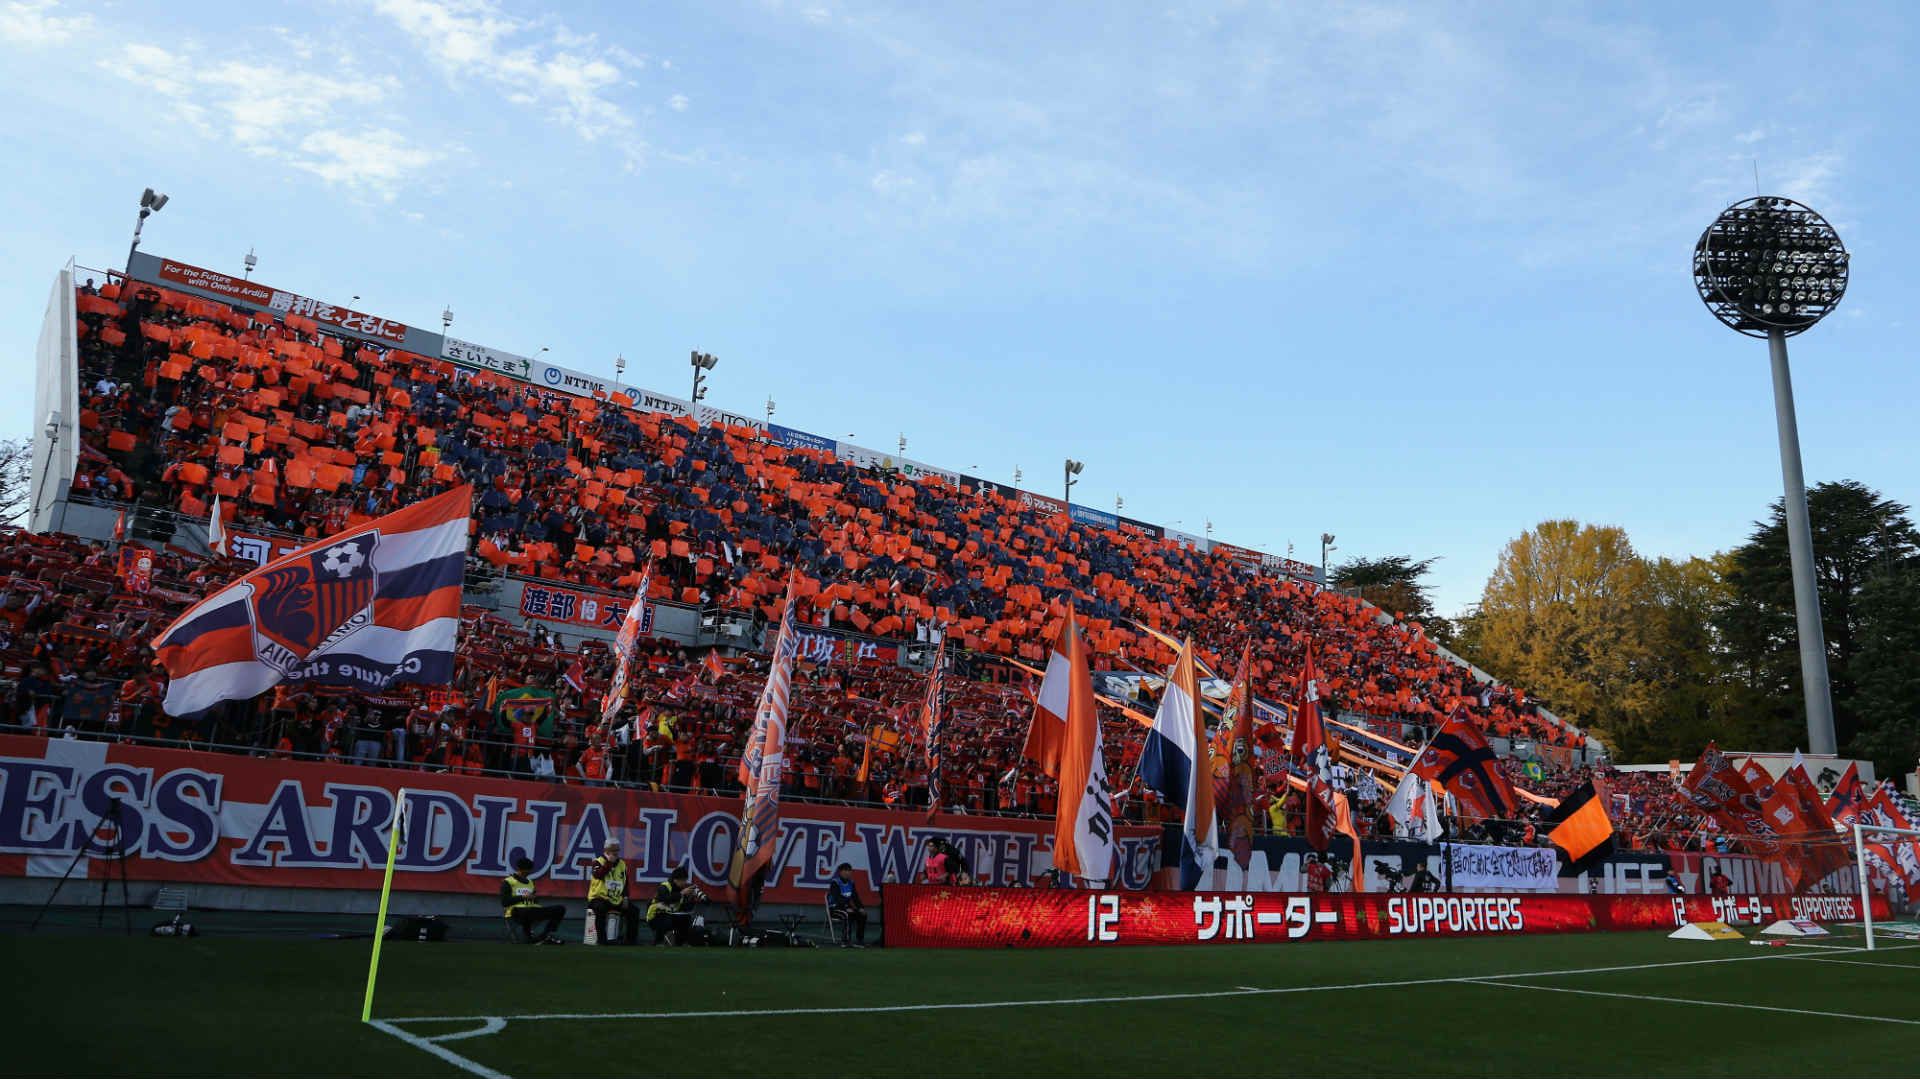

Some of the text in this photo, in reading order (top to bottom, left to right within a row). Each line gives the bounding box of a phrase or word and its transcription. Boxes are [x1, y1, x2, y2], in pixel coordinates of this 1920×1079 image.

[164, 263, 232, 285] For the Future
[188, 277, 270, 301] with Omiya Ardija
[449, 347, 517, 372] さいたま
[524, 588, 575, 619] 渡部
[580, 599, 597, 620] 13
[0, 755, 224, 863] ESS
[230, 778, 617, 887] ARDIJA
[1087, 894, 1524, 941] 12 サポーター SUPPORTERS
[1671, 896, 1856, 926] 12 サポーター SUPPORTERS
